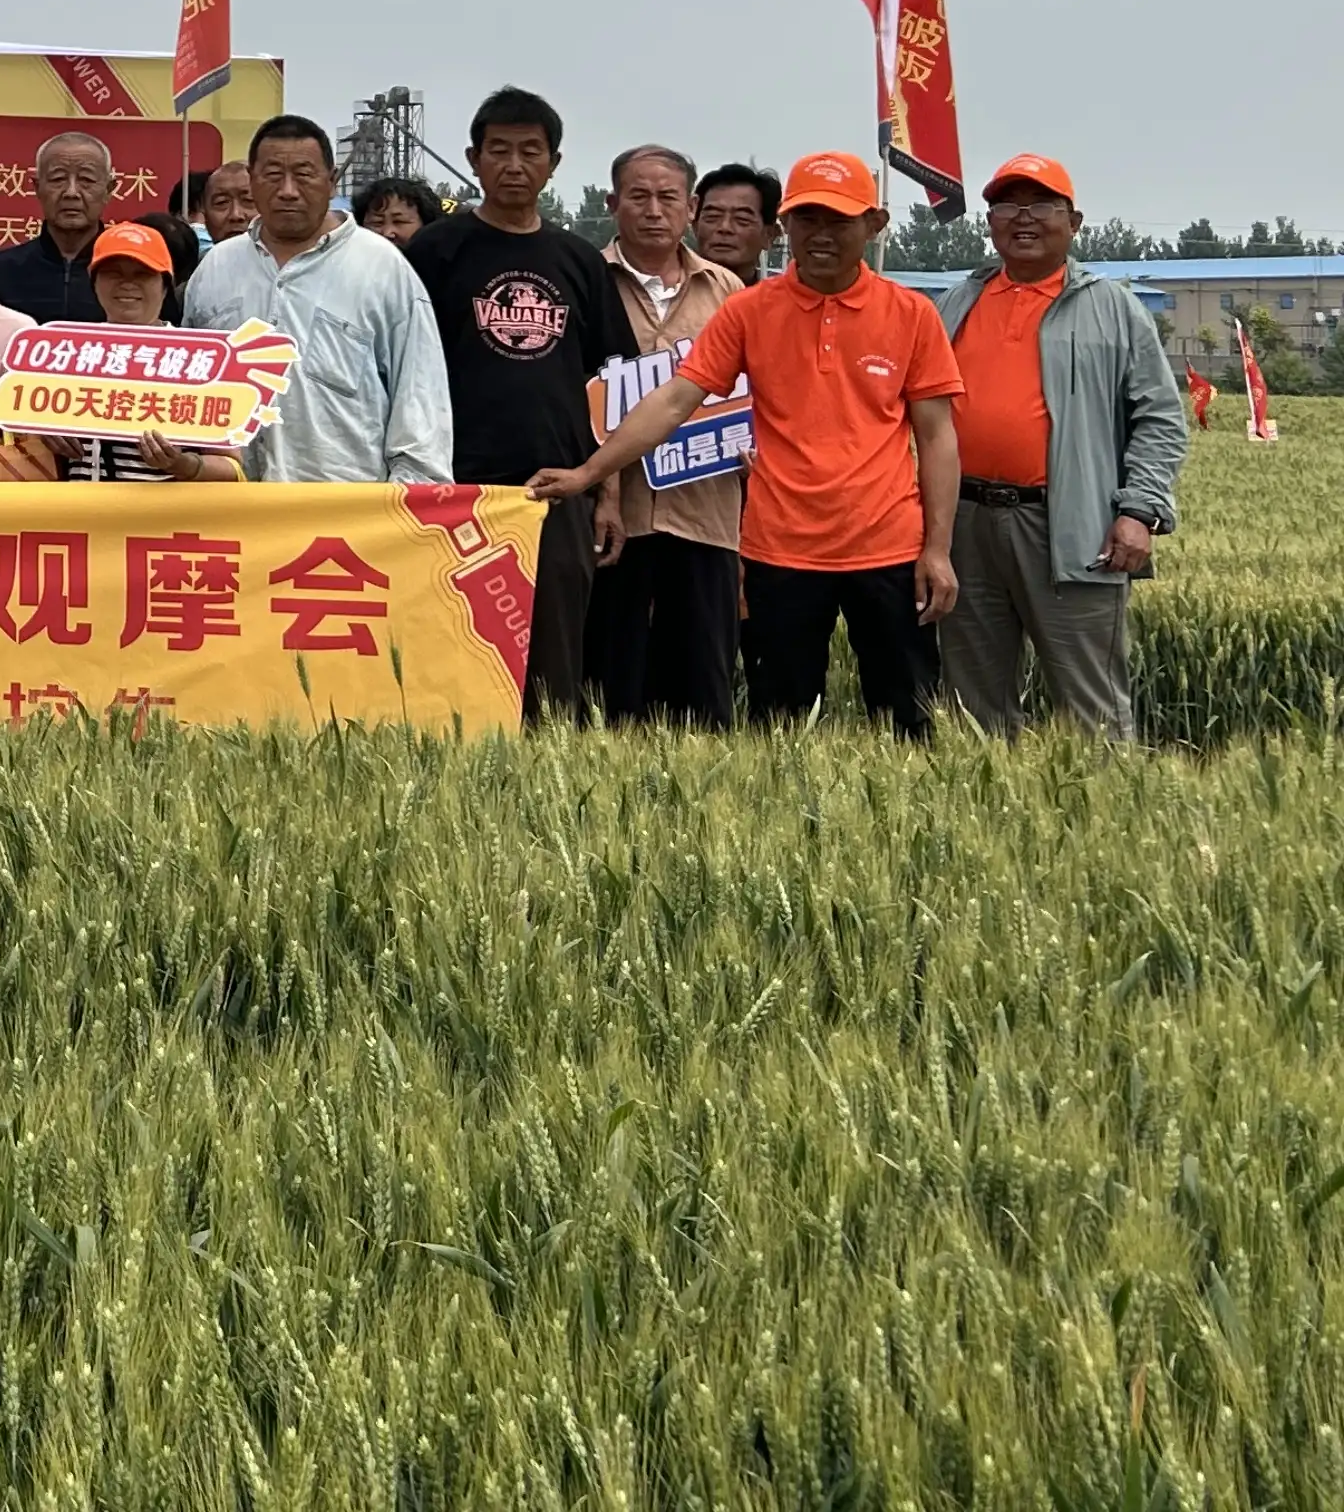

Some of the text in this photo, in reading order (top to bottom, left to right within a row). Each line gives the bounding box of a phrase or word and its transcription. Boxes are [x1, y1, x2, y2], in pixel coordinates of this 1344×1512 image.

[476, 299, 566, 336] VALUABLE
[12, 336, 216, 383] 10分钟透气破板
[11, 383, 233, 428] 100天控失锁肥
